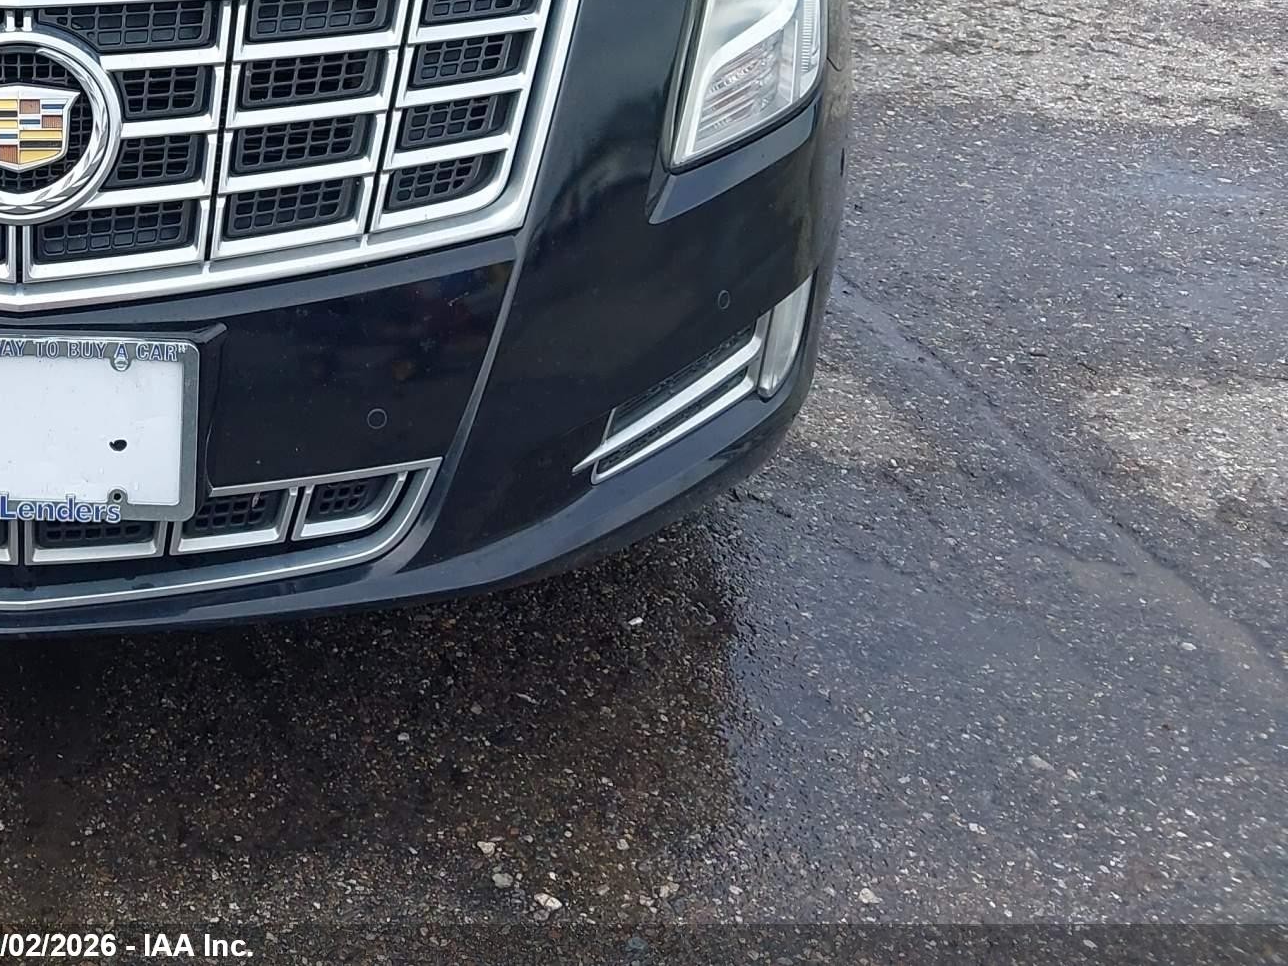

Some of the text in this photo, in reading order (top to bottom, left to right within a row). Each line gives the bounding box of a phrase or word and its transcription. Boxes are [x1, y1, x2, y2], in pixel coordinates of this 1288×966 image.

[33, 340, 60, 358] TO
[67, 341, 108, 359] BUY
[113, 341, 129, 360] A
